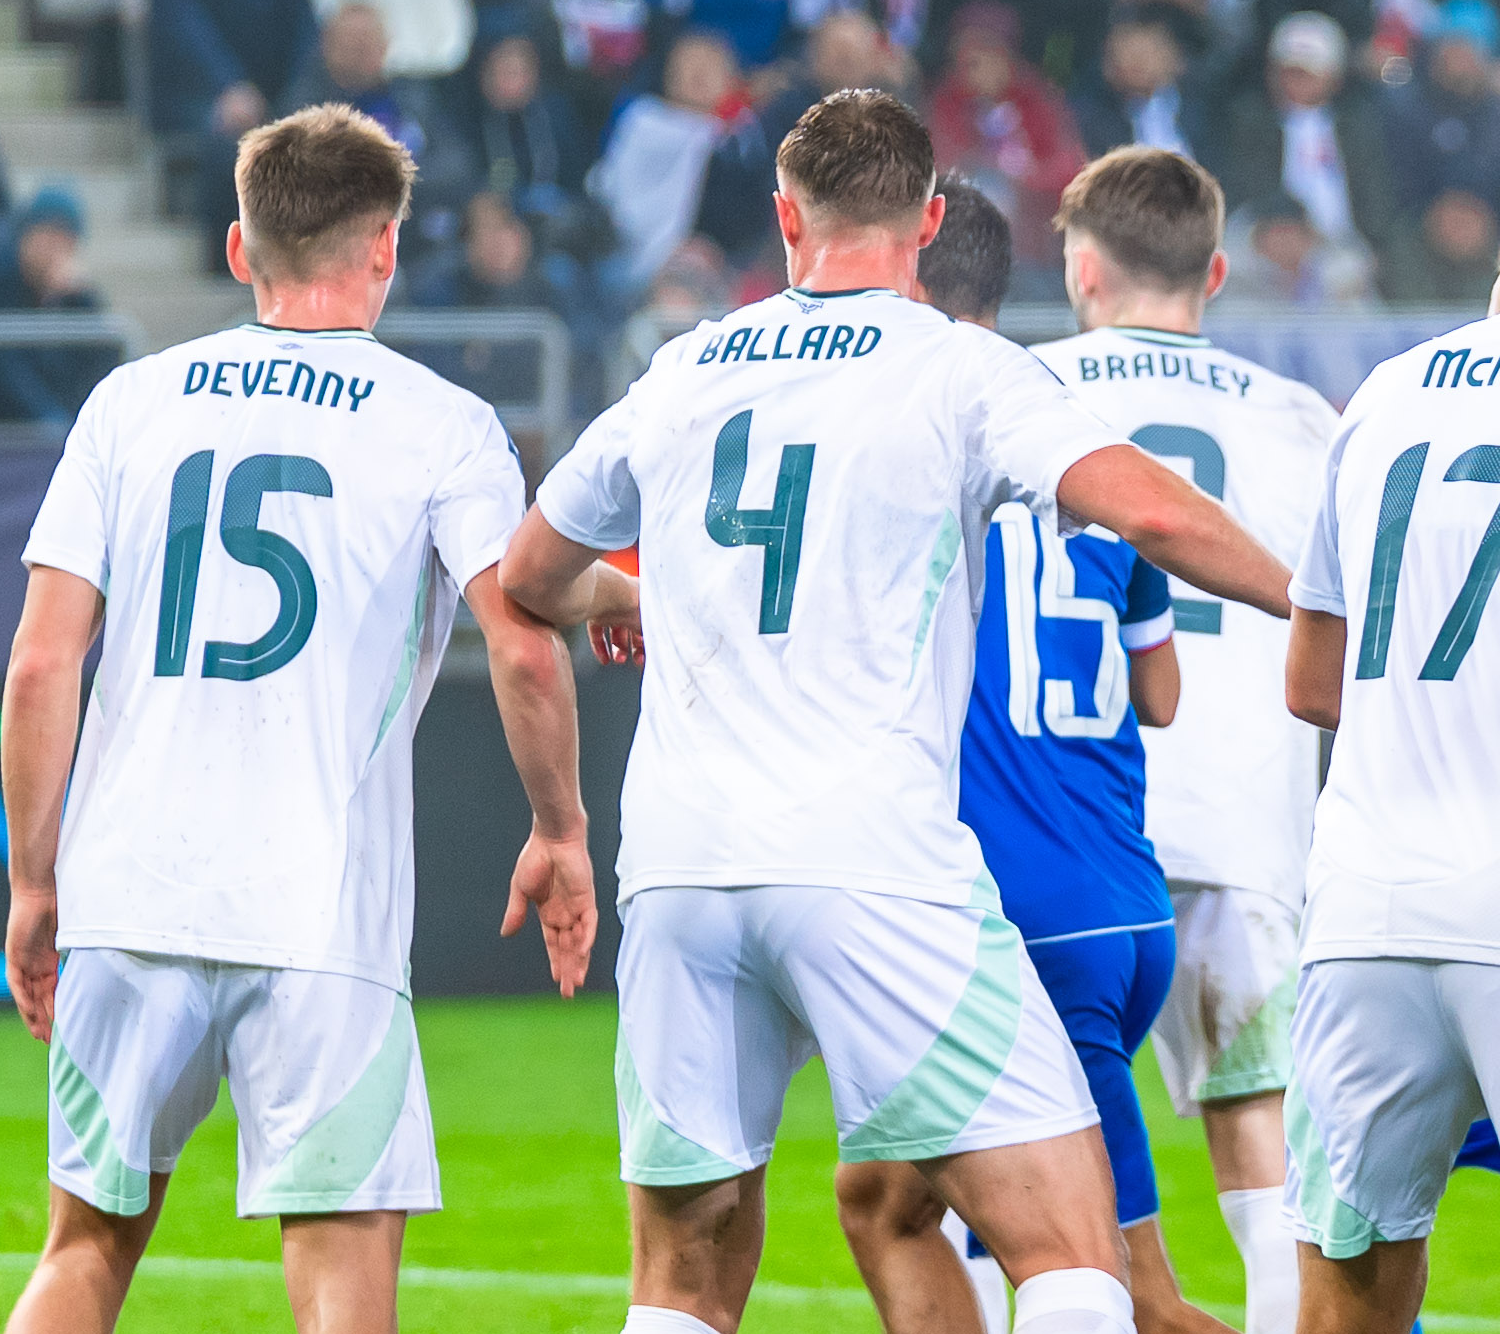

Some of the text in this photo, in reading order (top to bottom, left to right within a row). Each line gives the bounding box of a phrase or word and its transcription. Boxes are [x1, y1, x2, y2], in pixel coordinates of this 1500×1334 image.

[183, 359, 375, 413] DEVENNY
[697, 324, 882, 365] BALLARD
[1080, 353, 1252, 397] BRADLEY
[153, 449, 334, 682] 15
[704, 408, 817, 635] 4
[991, 500, 1130, 740] 15
